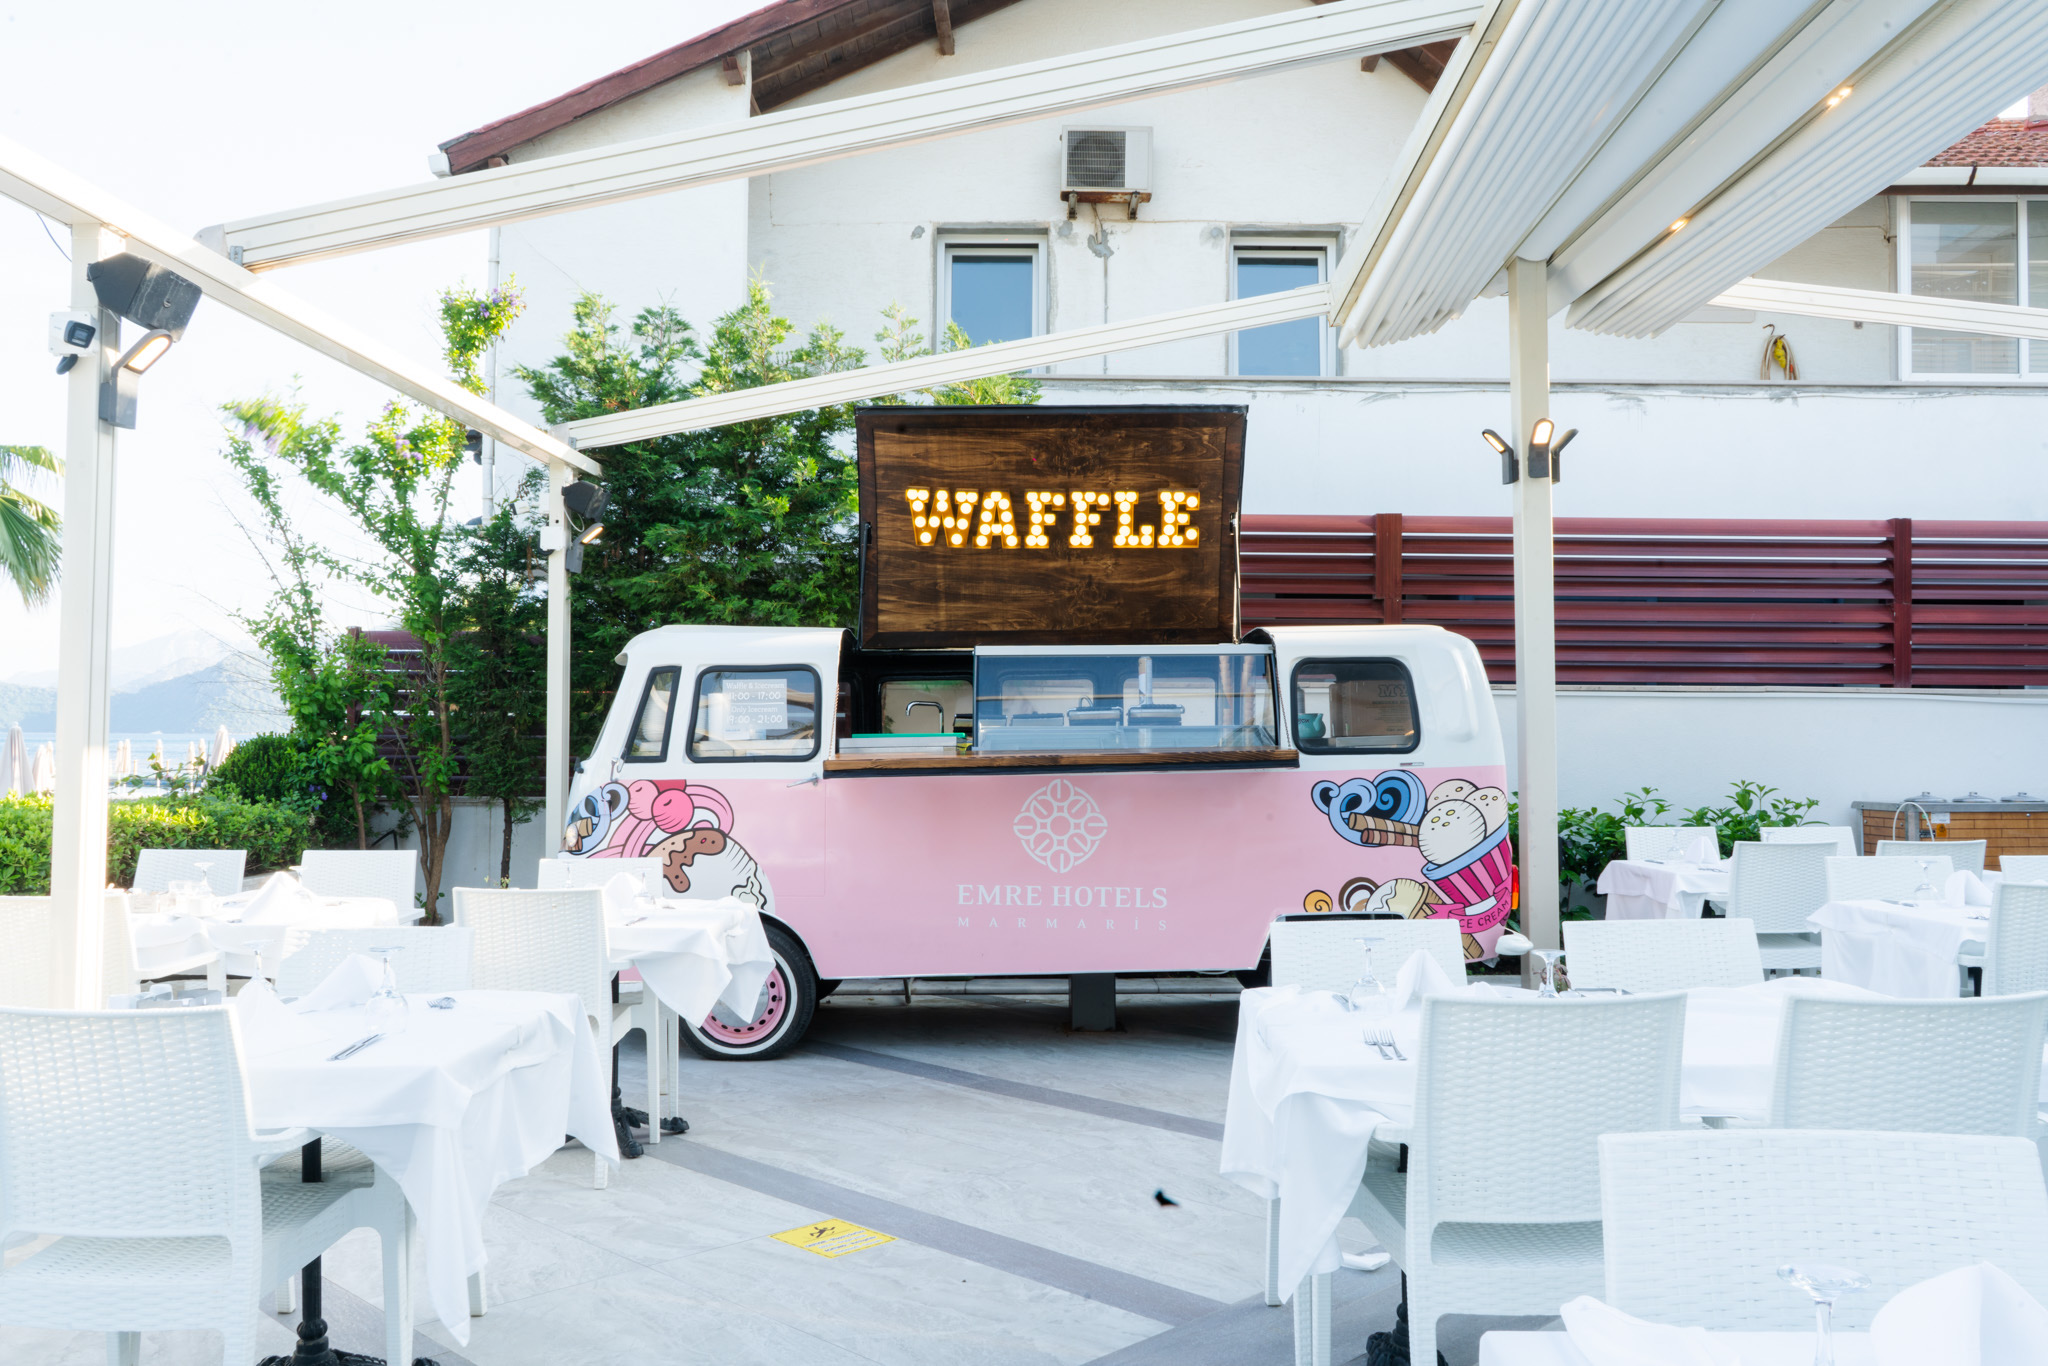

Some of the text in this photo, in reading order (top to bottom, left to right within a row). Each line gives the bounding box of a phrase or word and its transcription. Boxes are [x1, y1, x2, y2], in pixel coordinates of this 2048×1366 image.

[905, 487, 1201, 549] WAFFLE
[758, 691, 781, 700] 17:00
[731, 706, 747, 714] Only
[757, 714, 783, 723] 21:00
[957, 884, 1168, 908] EMRE HOTELS
[1459, 899, 1510, 929] CE CREAM
[957, 916, 1168, 931] MARMARİS
